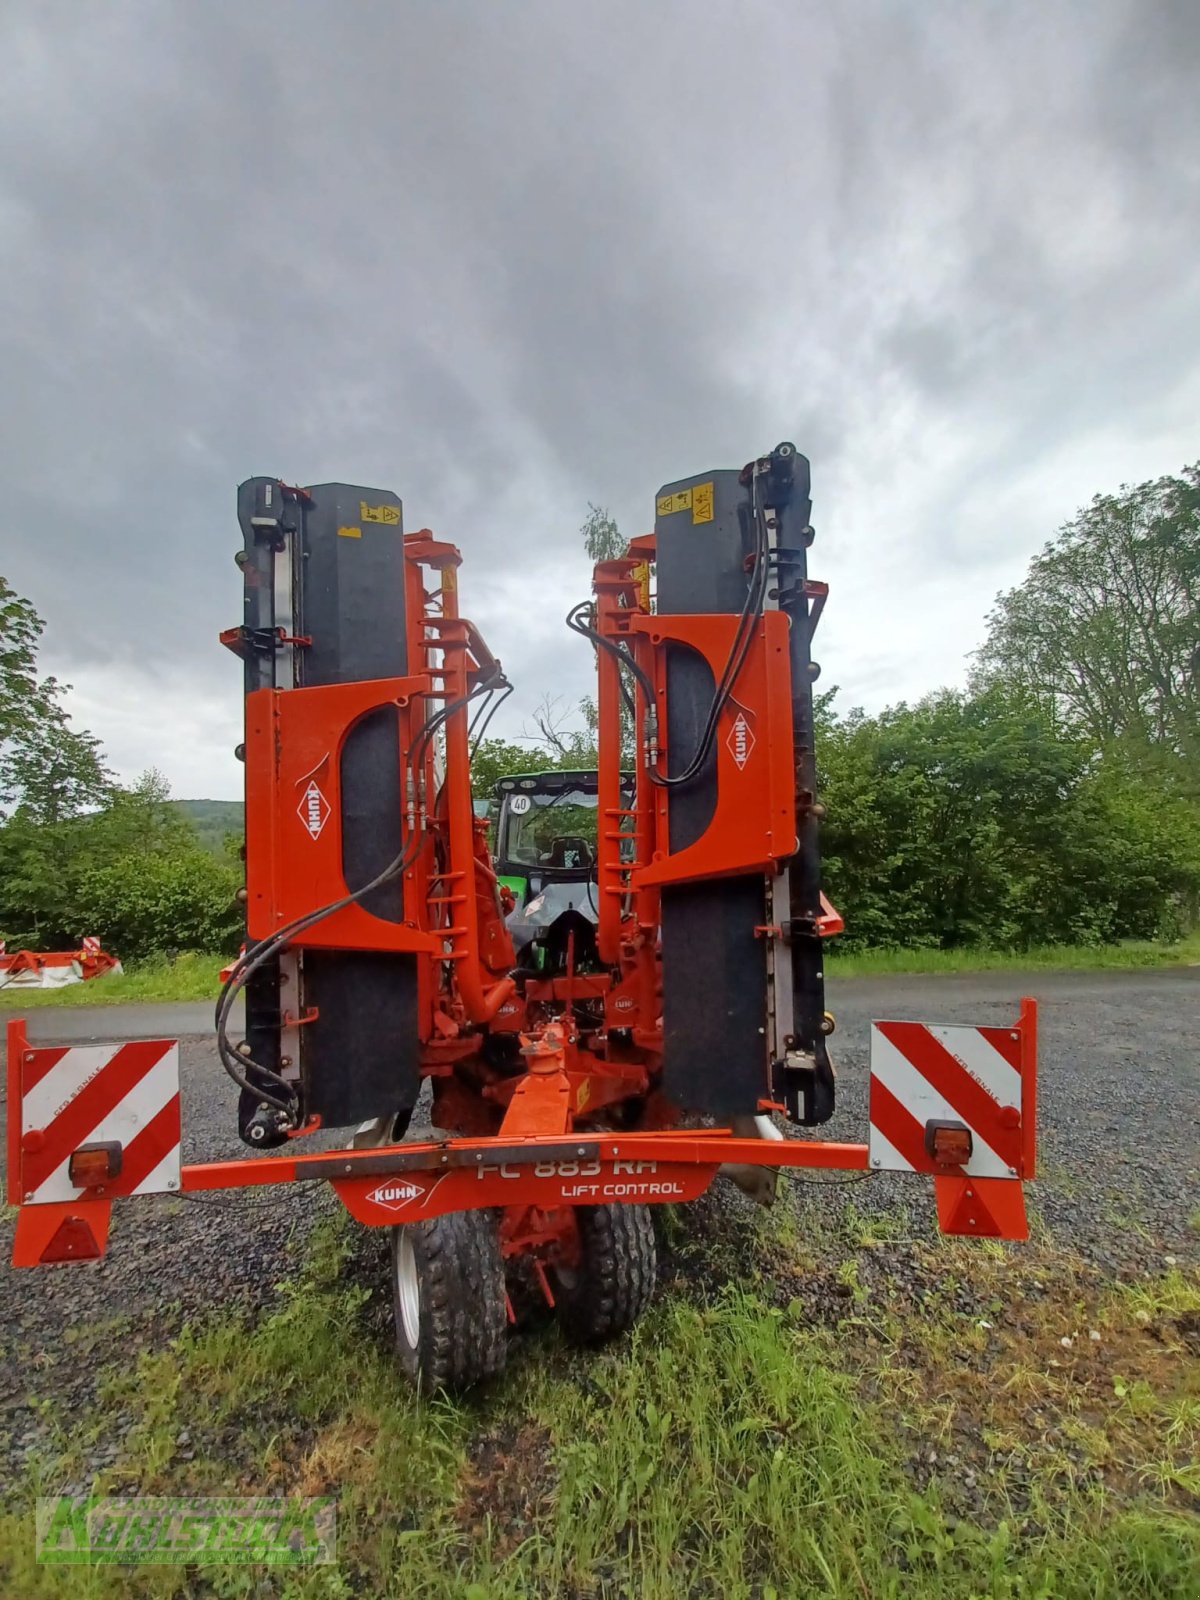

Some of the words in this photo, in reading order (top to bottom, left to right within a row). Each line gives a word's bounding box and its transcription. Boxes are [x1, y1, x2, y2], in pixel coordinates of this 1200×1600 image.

[735, 721, 746, 762] KUHN
[307, 790, 321, 832] KUHN
[514, 797, 526, 810] 40
[477, 1162, 520, 1179] FC
[534, 1160, 601, 1177] 883
[374, 1184, 416, 1202] KUHN
[561, 1185, 600, 1197] LIFT
[603, 1182, 683, 1196] CONTROL
